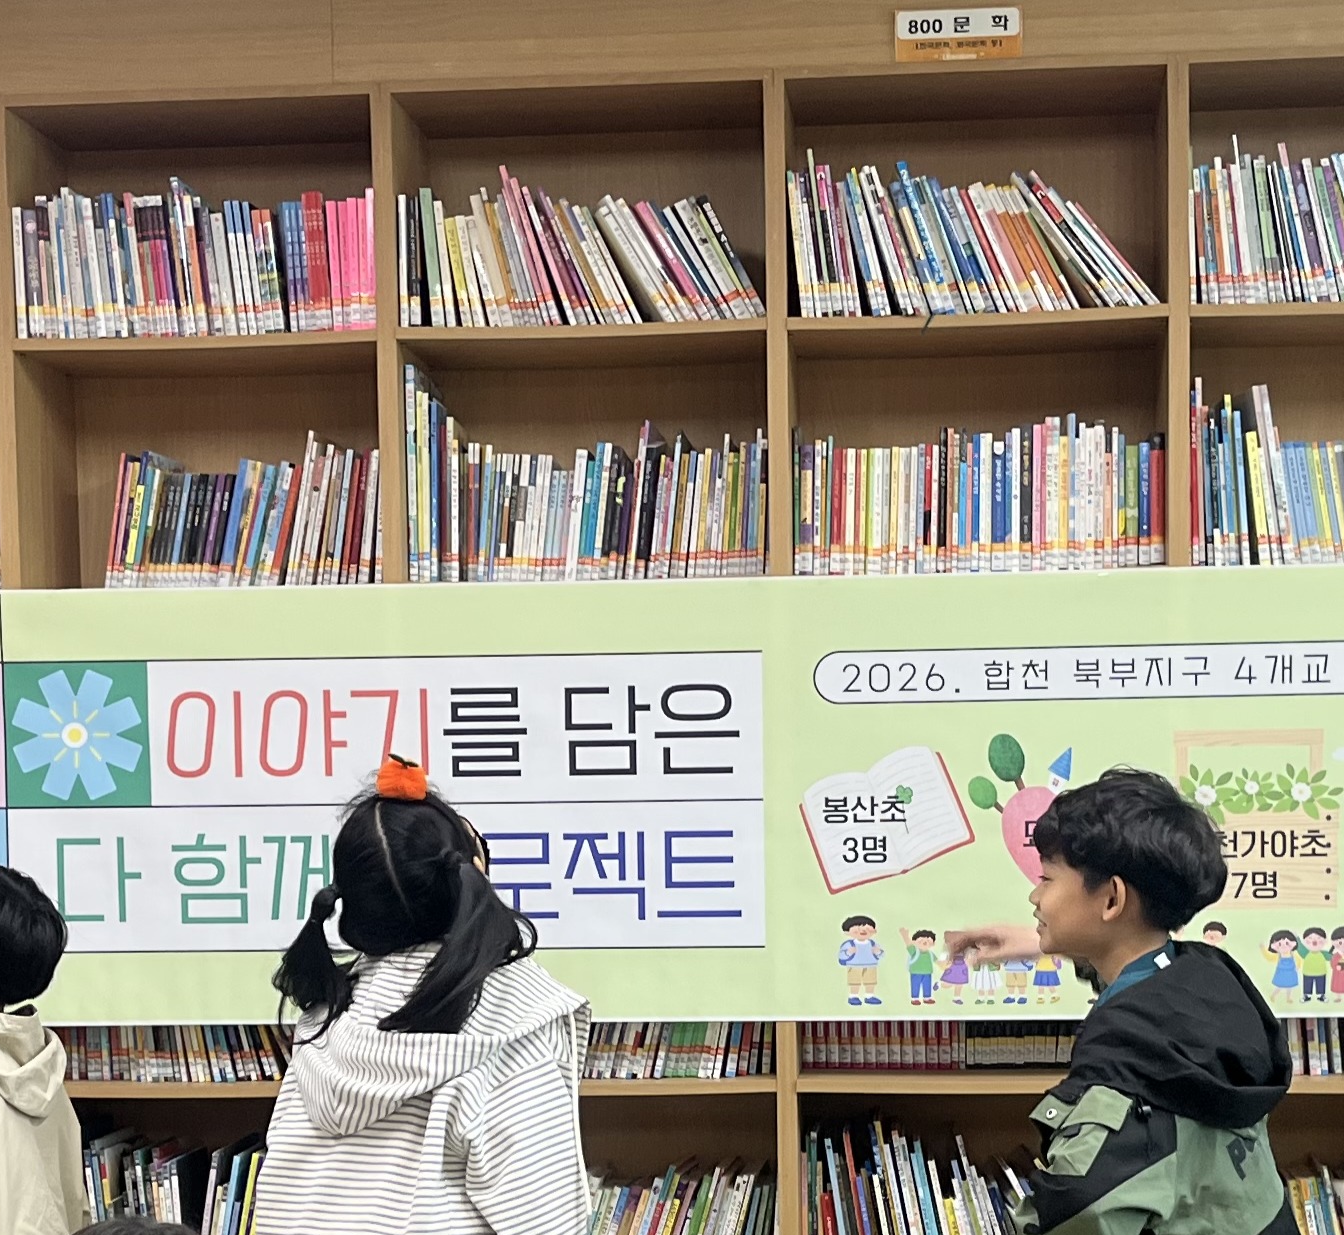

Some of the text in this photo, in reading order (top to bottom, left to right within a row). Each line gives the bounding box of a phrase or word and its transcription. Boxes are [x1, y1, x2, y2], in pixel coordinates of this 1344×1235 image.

[908, 19, 943, 34] 800
[841, 662, 961, 694] 2026.
[983, 657, 1051, 692] 합천
[1072, 654, 1213, 689] 북부지구
[1233, 653, 1332, 687] 4개교
[166, 683, 741, 778] 이야기를 담은
[821, 793, 908, 826] 봉산초
[841, 834, 890, 866] 3명
[1218, 829, 1328, 860] 천가야초
[56, 836, 142, 923] 다
[486, 829, 742, 921] 로젝트
[1230, 870, 1280, 900] 7명
